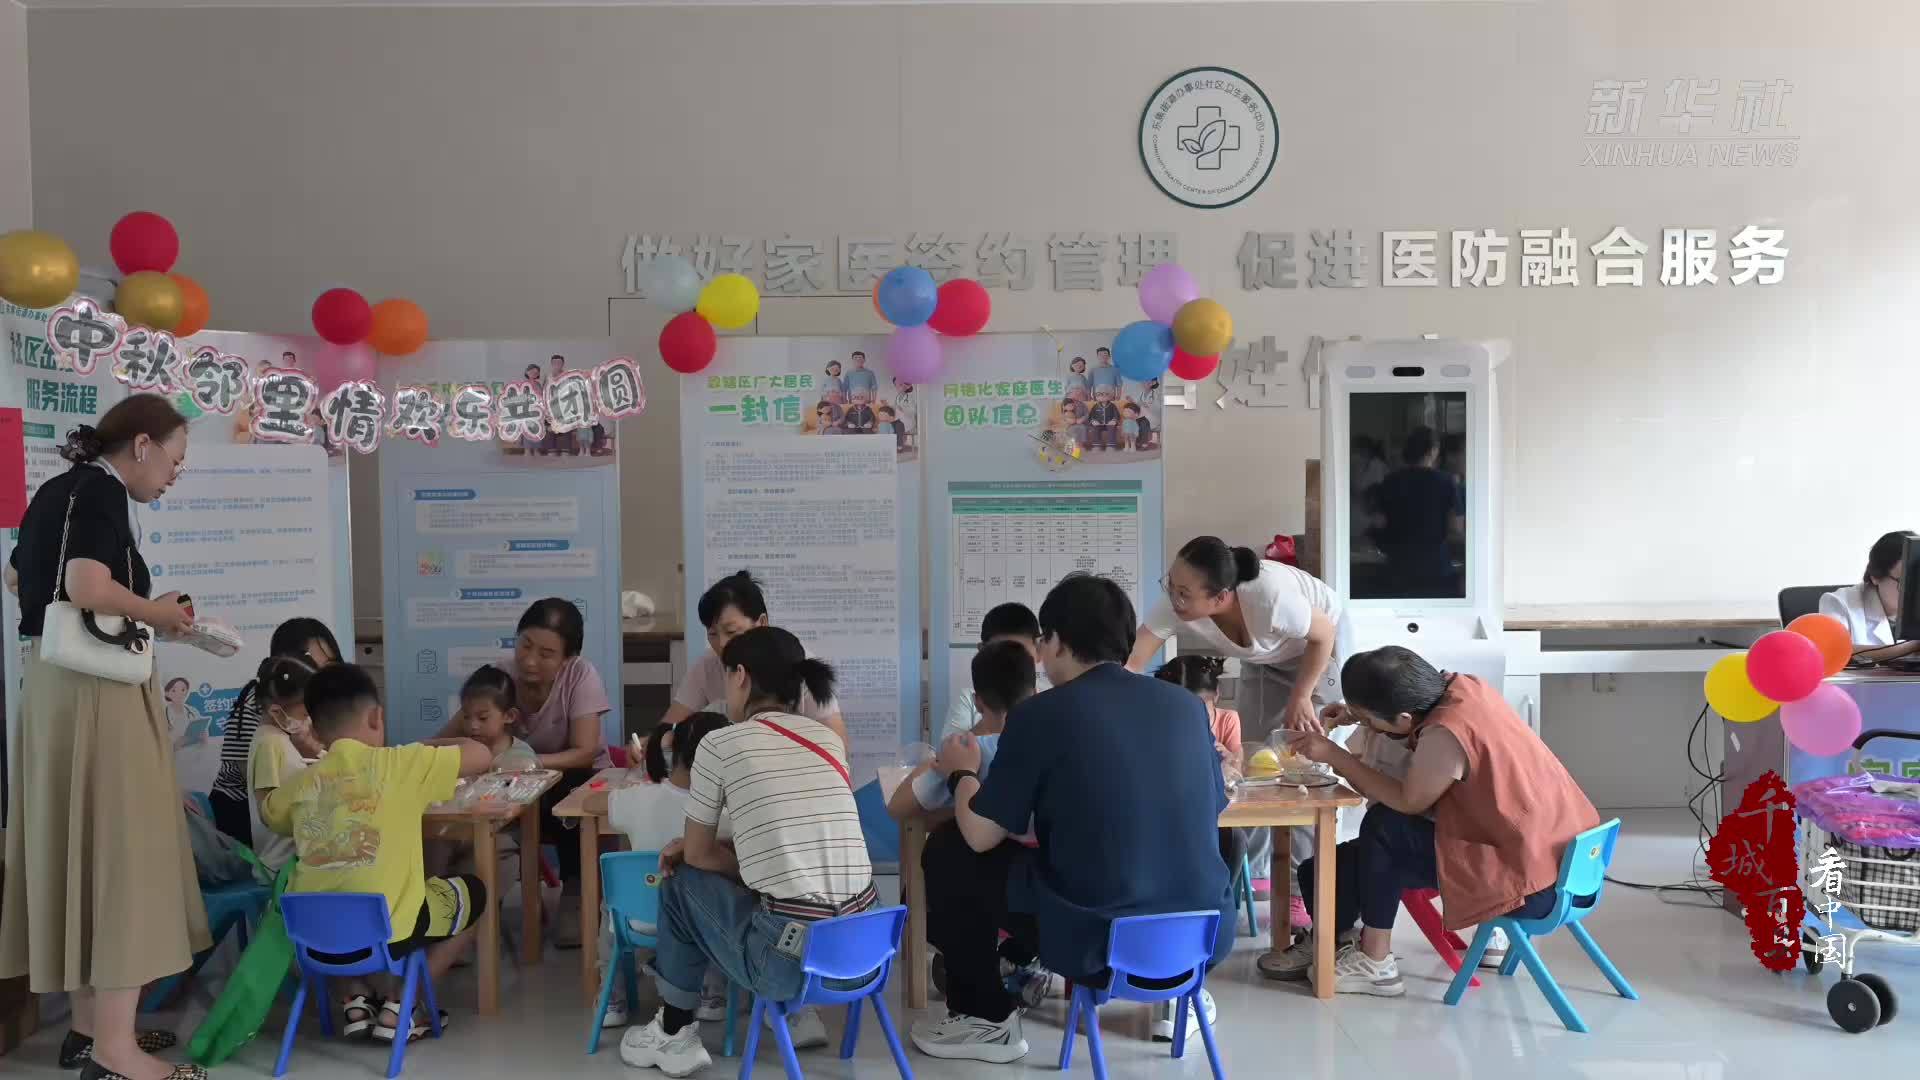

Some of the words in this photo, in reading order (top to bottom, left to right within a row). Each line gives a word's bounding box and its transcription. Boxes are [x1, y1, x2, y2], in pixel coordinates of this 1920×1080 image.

[1237, 226, 1789, 292] 促进医防融合服务
[27, 378, 98, 415] 服务流程
[708, 394, 800, 424] 一封信
[944, 402, 1038, 426] 团队信息
